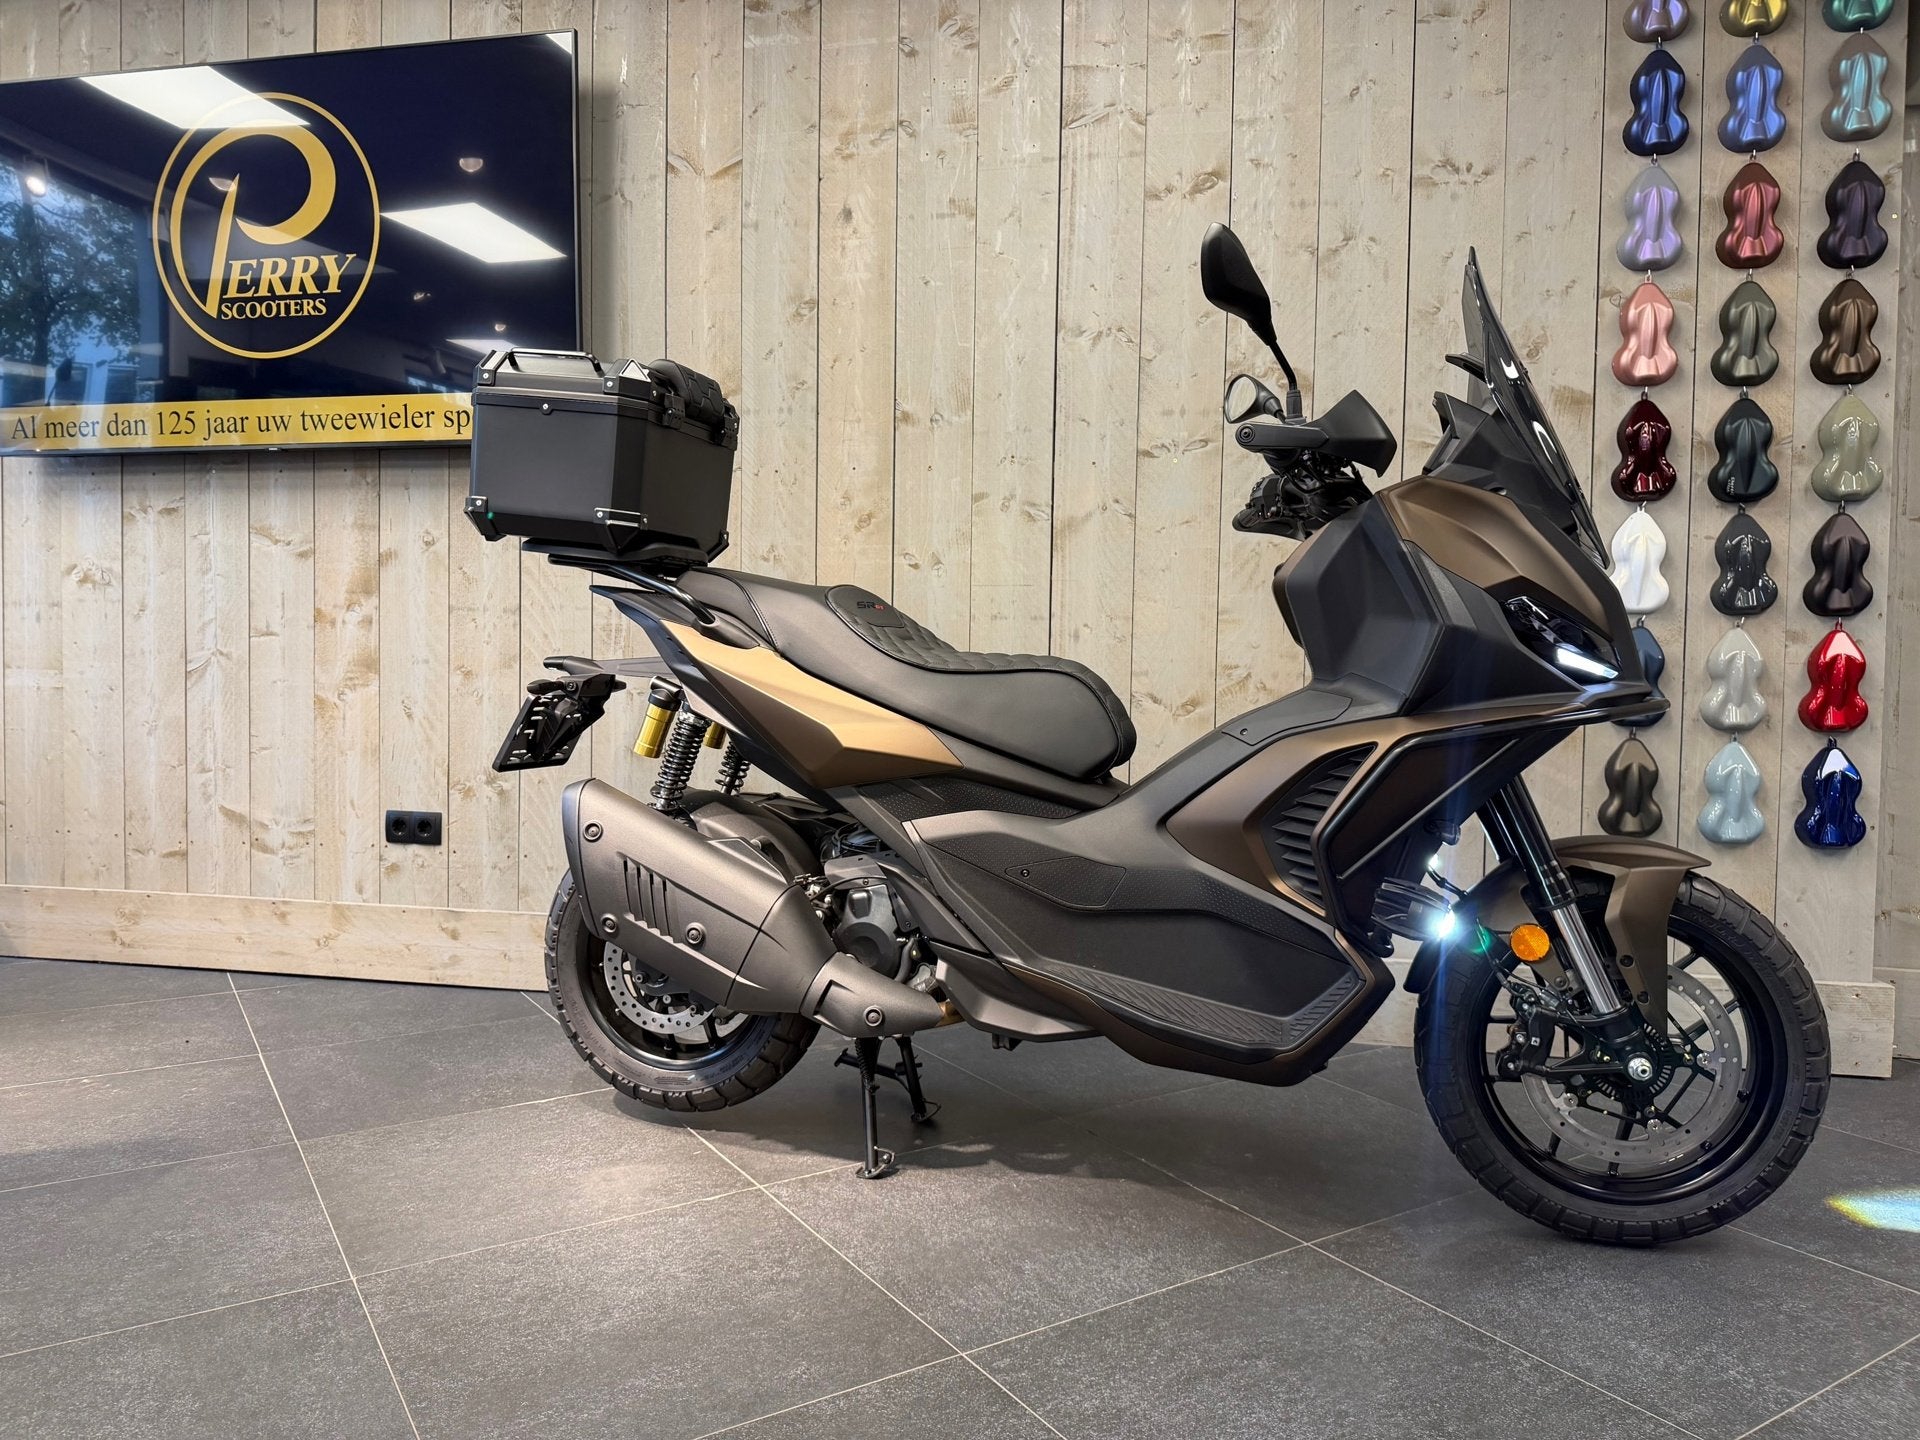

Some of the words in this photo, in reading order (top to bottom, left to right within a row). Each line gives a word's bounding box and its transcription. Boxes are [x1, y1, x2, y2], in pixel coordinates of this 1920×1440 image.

[170, 119, 356, 318] PERRY
[221, 298, 327, 320] SCOOTERS
[11, 415, 37, 440] Al
[44, 417, 100, 438] meer
[106, 412, 148, 438] dan
[157, 410, 196, 436] 125
[203, 409, 249, 441] jaar
[256, 414, 292, 433] uw
[300, 403, 435, 432] tweewieler
